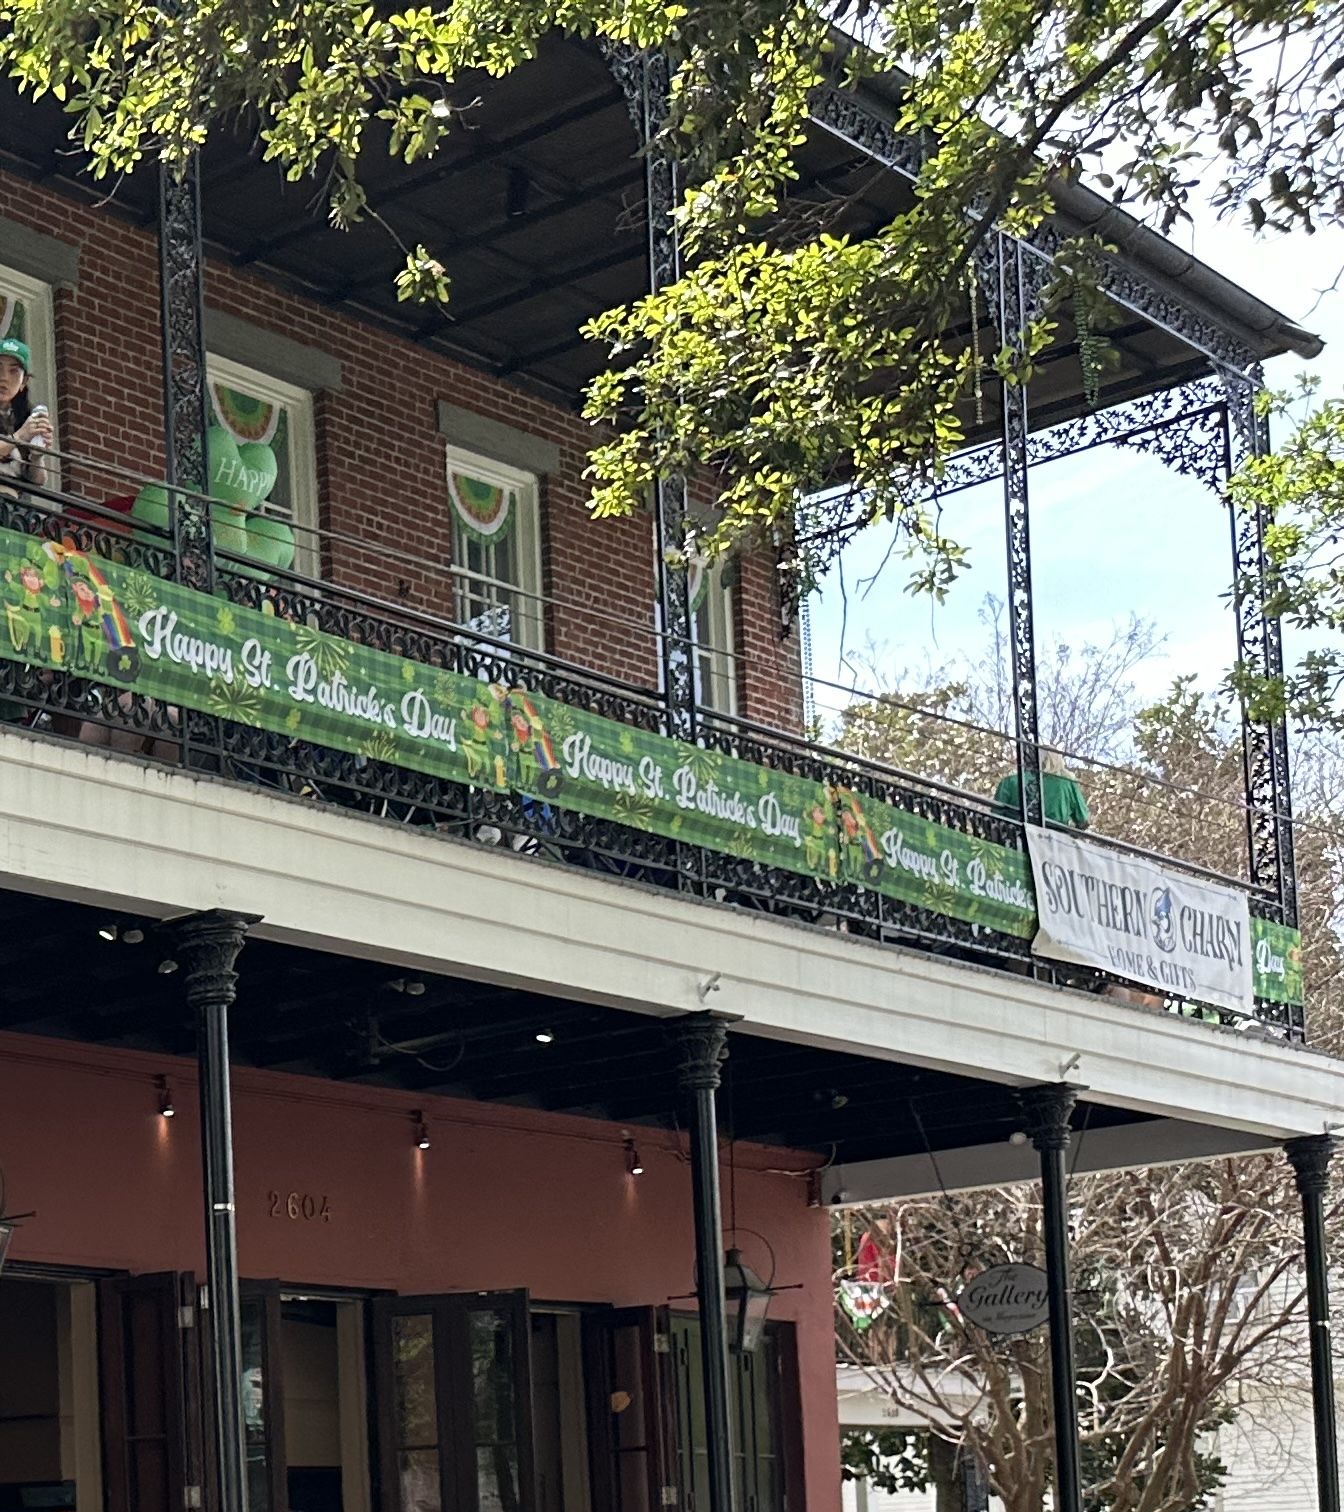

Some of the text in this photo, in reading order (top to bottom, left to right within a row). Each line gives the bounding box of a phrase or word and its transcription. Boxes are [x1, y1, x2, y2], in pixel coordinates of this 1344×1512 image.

[138, 606, 457, 752] Happy St. Patrick's Day
[563, 730, 801, 847] Happy St. Patrick's Day
[881, 827, 942, 885] Happy
[1042, 860, 1243, 972] SOUTHERN CHARM
[1161, 958, 1197, 993] GIFTS
[268, 1190, 330, 1223] 2604
[967, 1284, 1050, 1311] Gallery
